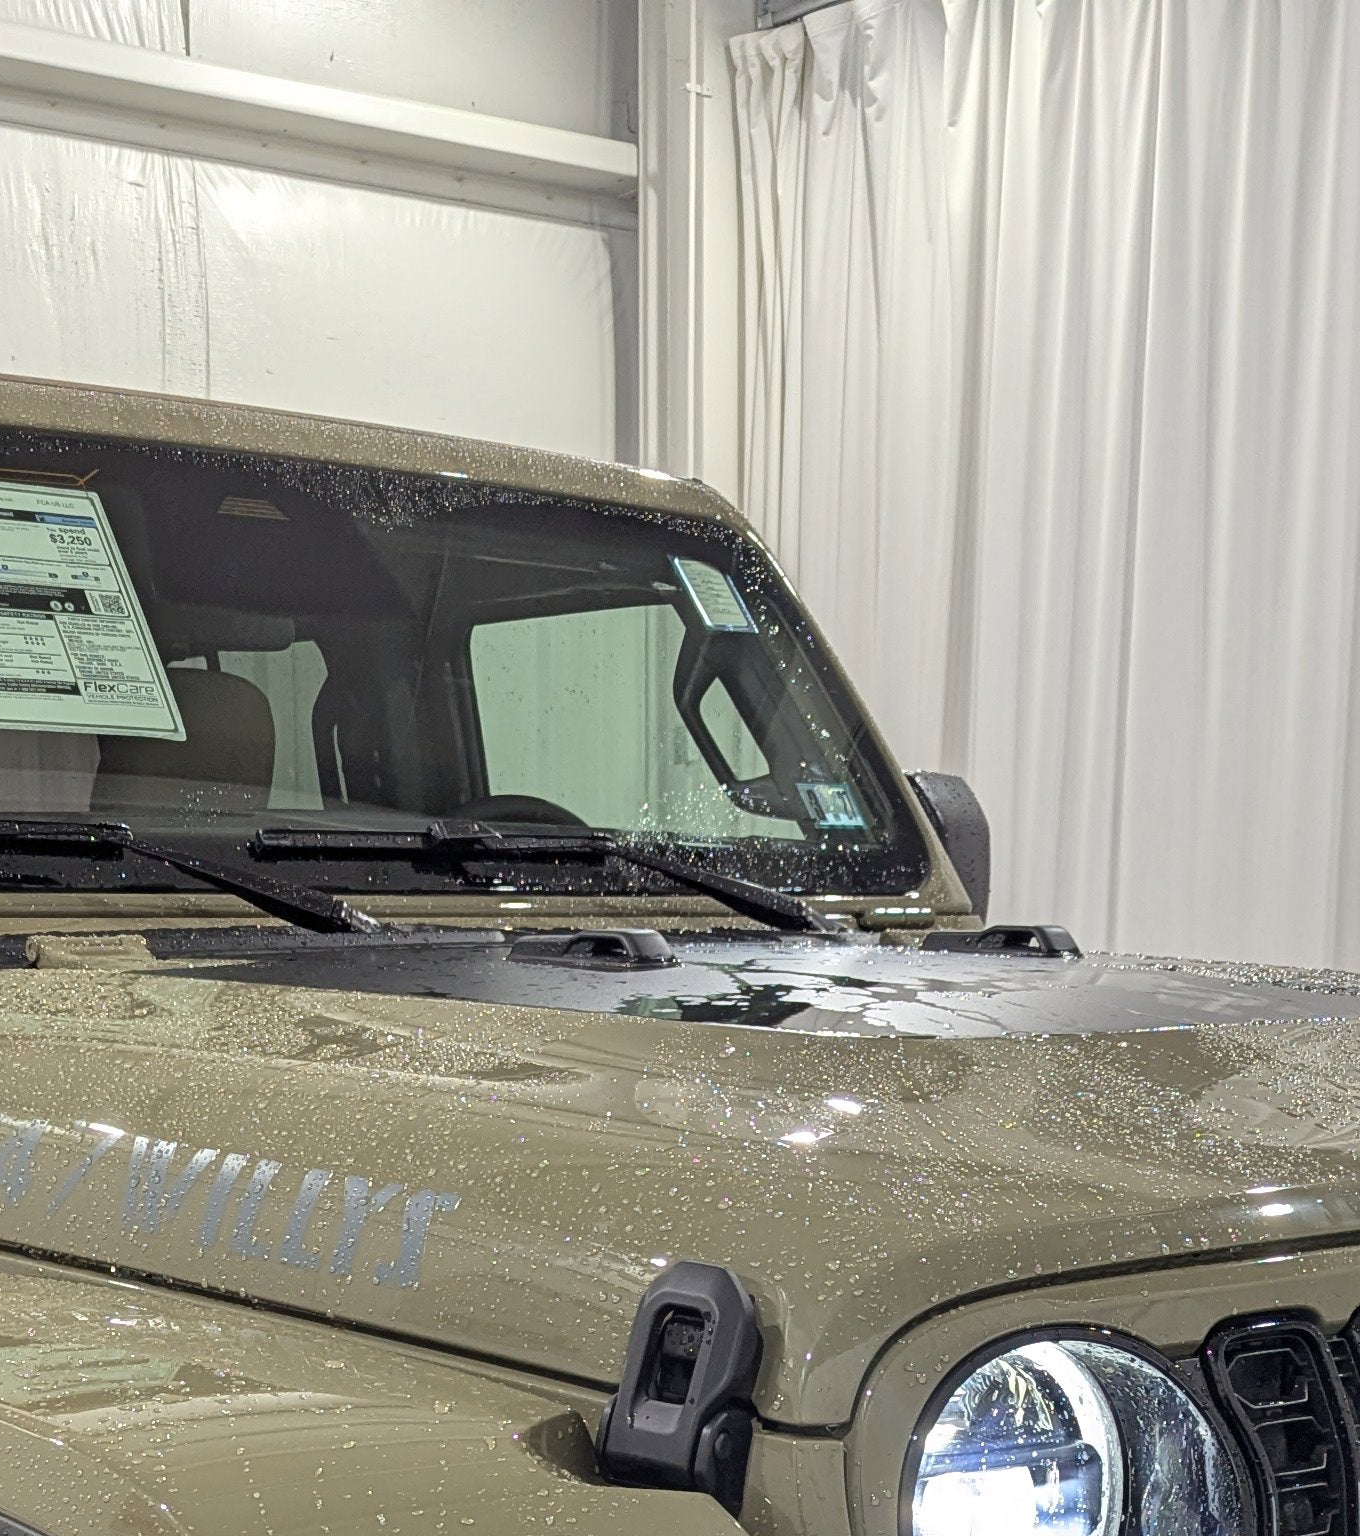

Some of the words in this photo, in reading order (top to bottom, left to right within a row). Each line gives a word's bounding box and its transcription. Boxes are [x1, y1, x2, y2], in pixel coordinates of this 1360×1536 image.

[58, 527, 86, 536] spend
[49, 533, 91, 547] $3,250
[83, 682, 155, 695] FlexCare
[126, 1134, 462, 1288] WILLYS
